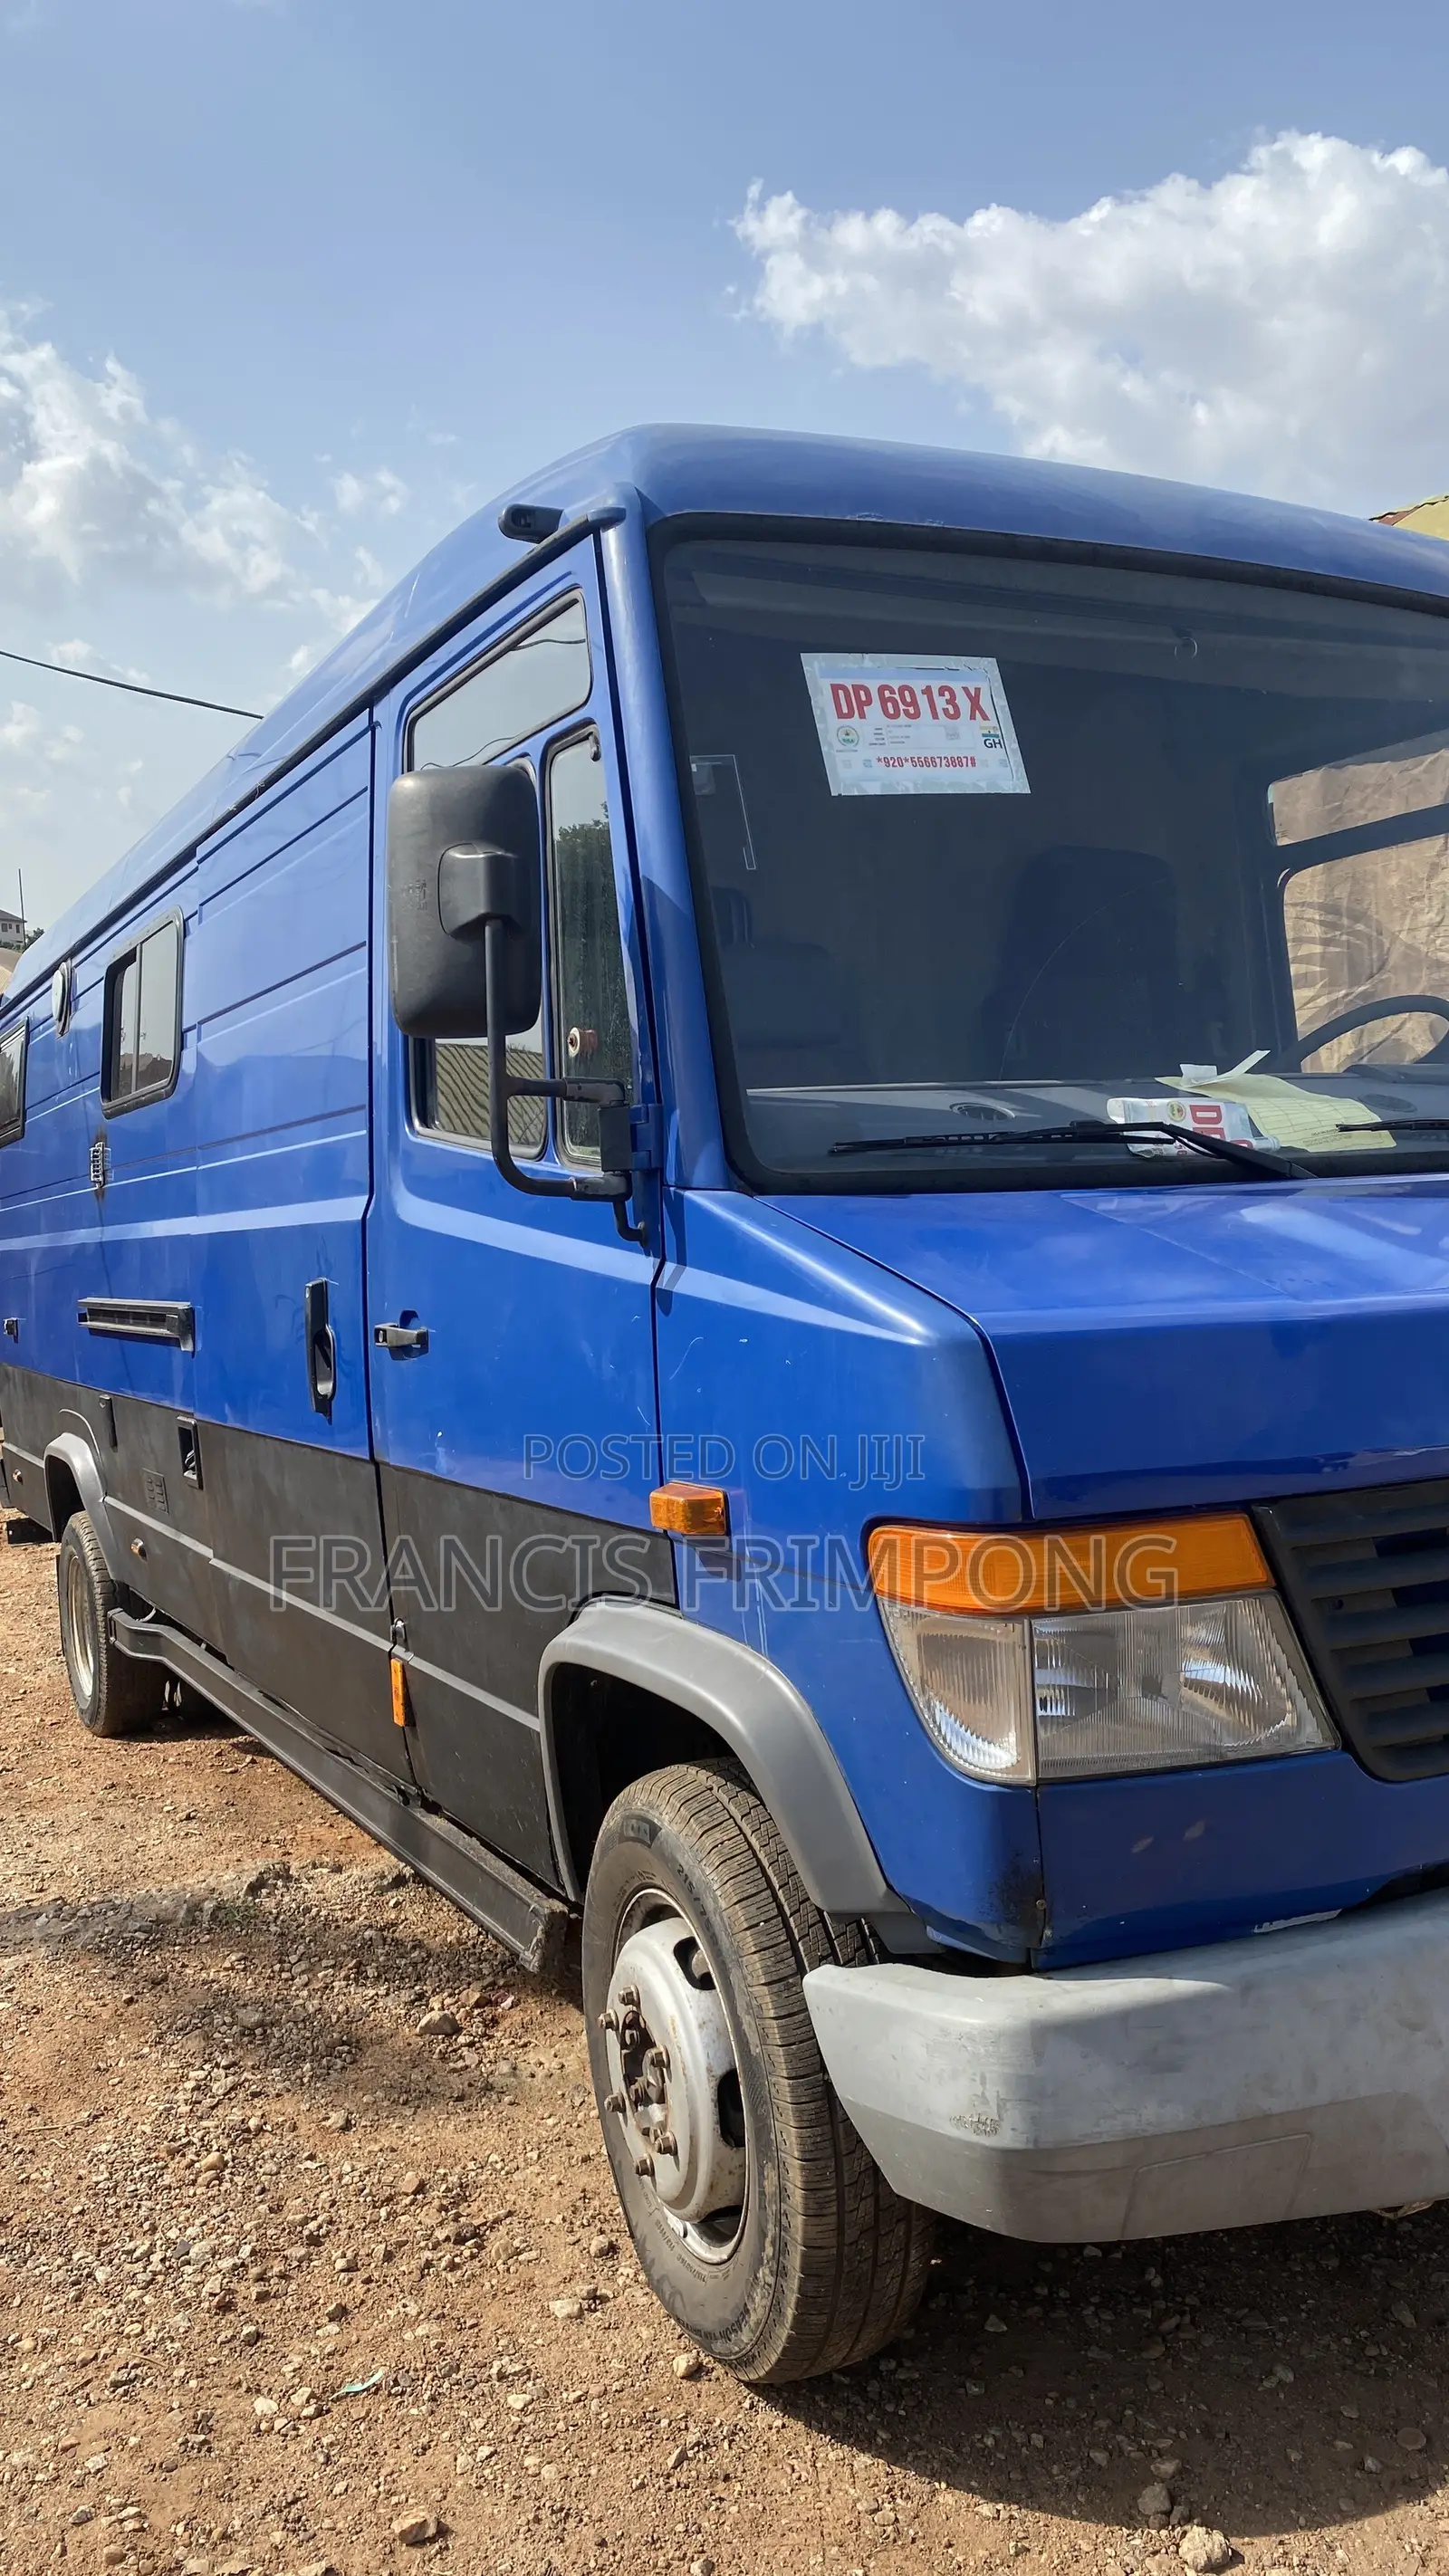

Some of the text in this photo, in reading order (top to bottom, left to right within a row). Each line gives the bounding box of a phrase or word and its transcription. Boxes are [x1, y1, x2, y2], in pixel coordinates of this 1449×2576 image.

[830, 683, 991, 721] DP 6913 X
[984, 738, 1003, 749] GH
